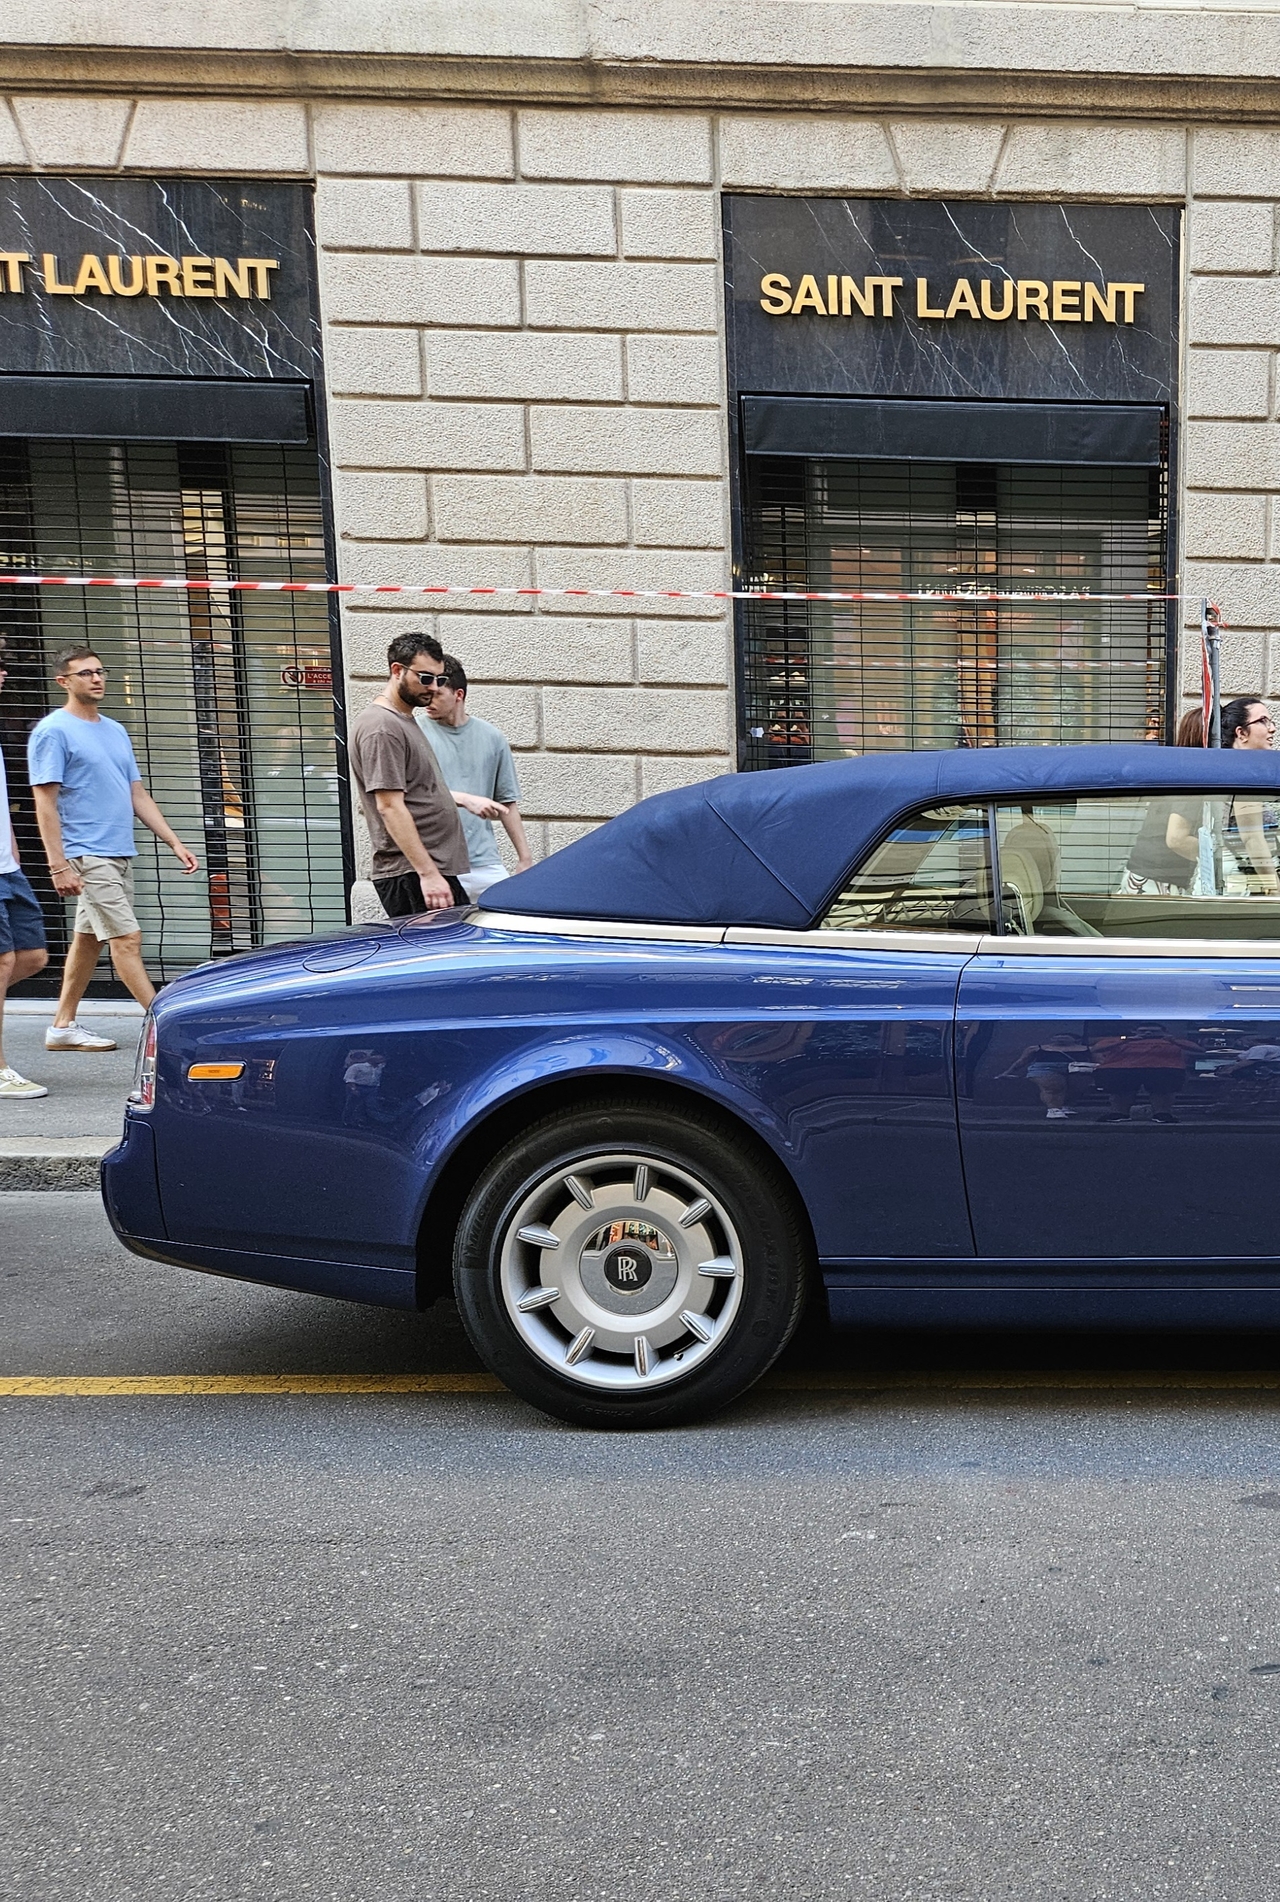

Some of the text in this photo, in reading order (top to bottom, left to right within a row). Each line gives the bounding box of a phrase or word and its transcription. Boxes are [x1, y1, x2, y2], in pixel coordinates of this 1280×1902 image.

[43, 253, 280, 299] LAURENT
[760, 272, 1145, 324] SAINT LAURENT
[617, 1256, 639, 1282] RR
